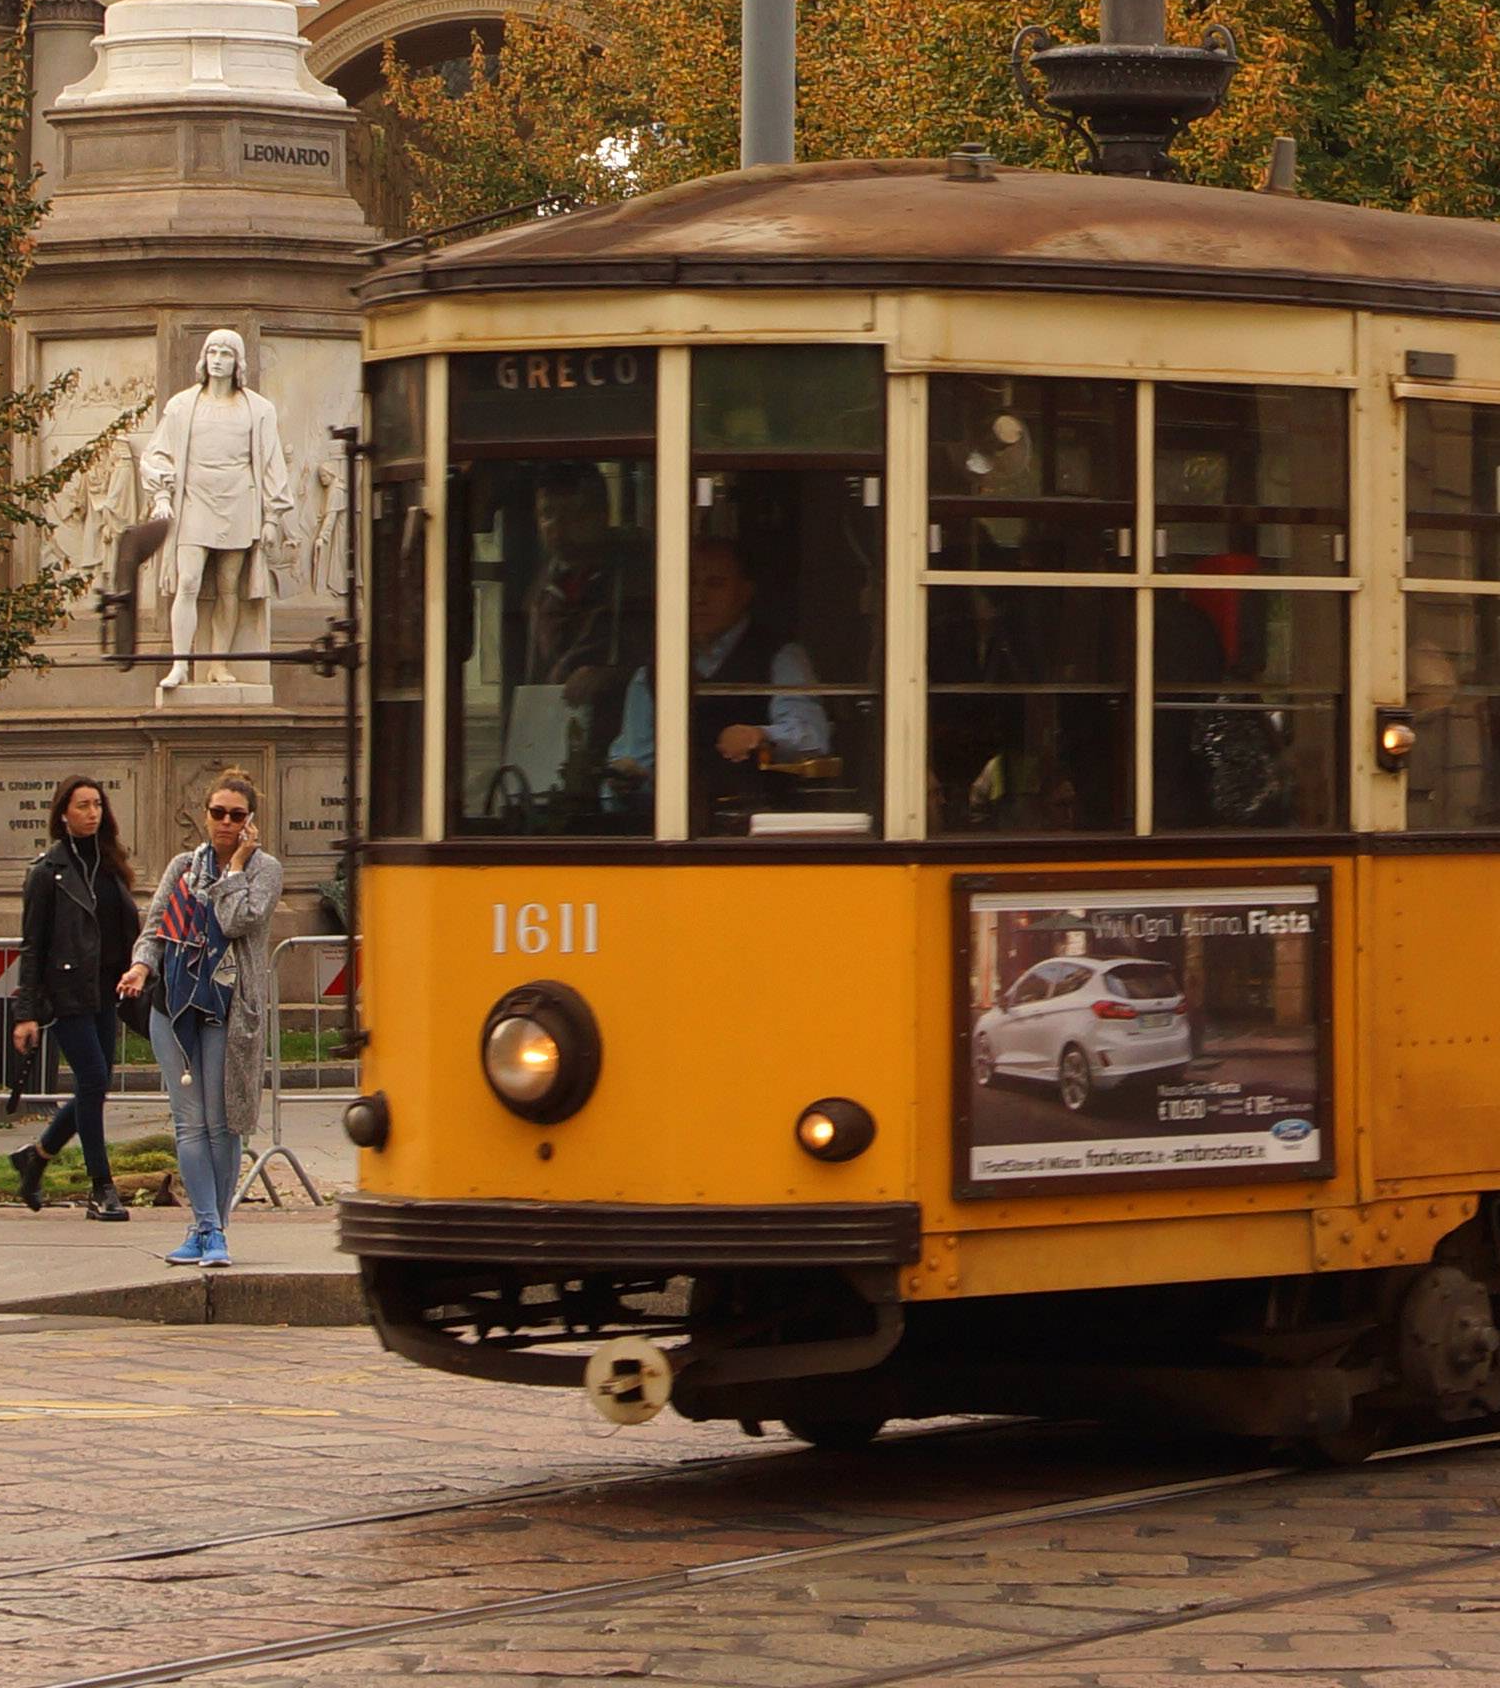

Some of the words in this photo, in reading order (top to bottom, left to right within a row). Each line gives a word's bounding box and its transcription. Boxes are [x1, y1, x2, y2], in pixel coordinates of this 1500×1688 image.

[243, 143, 330, 167] LEONARDO
[497, 354, 639, 389] GRECO
[8, 819, 47, 830] QUESTO
[491, 902, 599, 954] 1611
